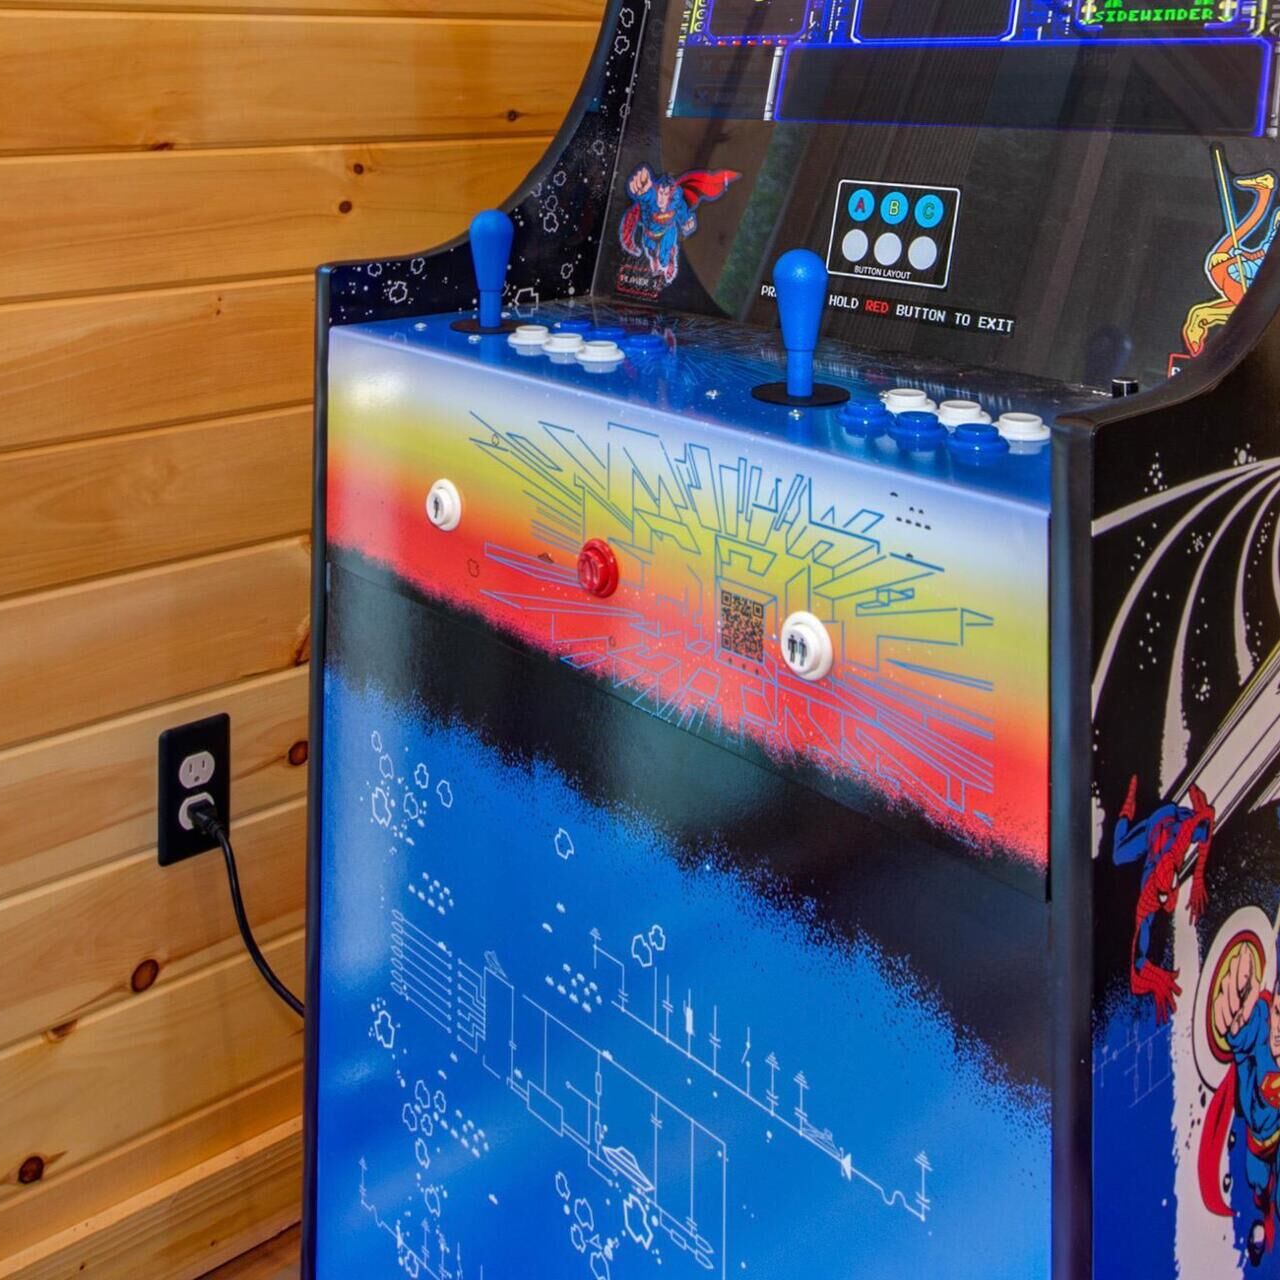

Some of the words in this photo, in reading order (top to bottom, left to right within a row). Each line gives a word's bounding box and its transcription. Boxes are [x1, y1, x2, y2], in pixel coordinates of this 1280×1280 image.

[1095, 8, 1214, 23] SIDEWINDER
[853, 196, 866, 214] A
[888, 200, 901, 217] B
[922, 202, 936, 220] C
[853, 264, 882, 278] BUTTON
[882, 268, 912, 281] LAYOUT
[828, 293, 860, 310] HOLD
[864, 299, 889, 315] RED
[895, 303, 947, 322] BUTTON
[954, 311, 971, 327] TO
[977, 315, 1015, 333] EXIT
